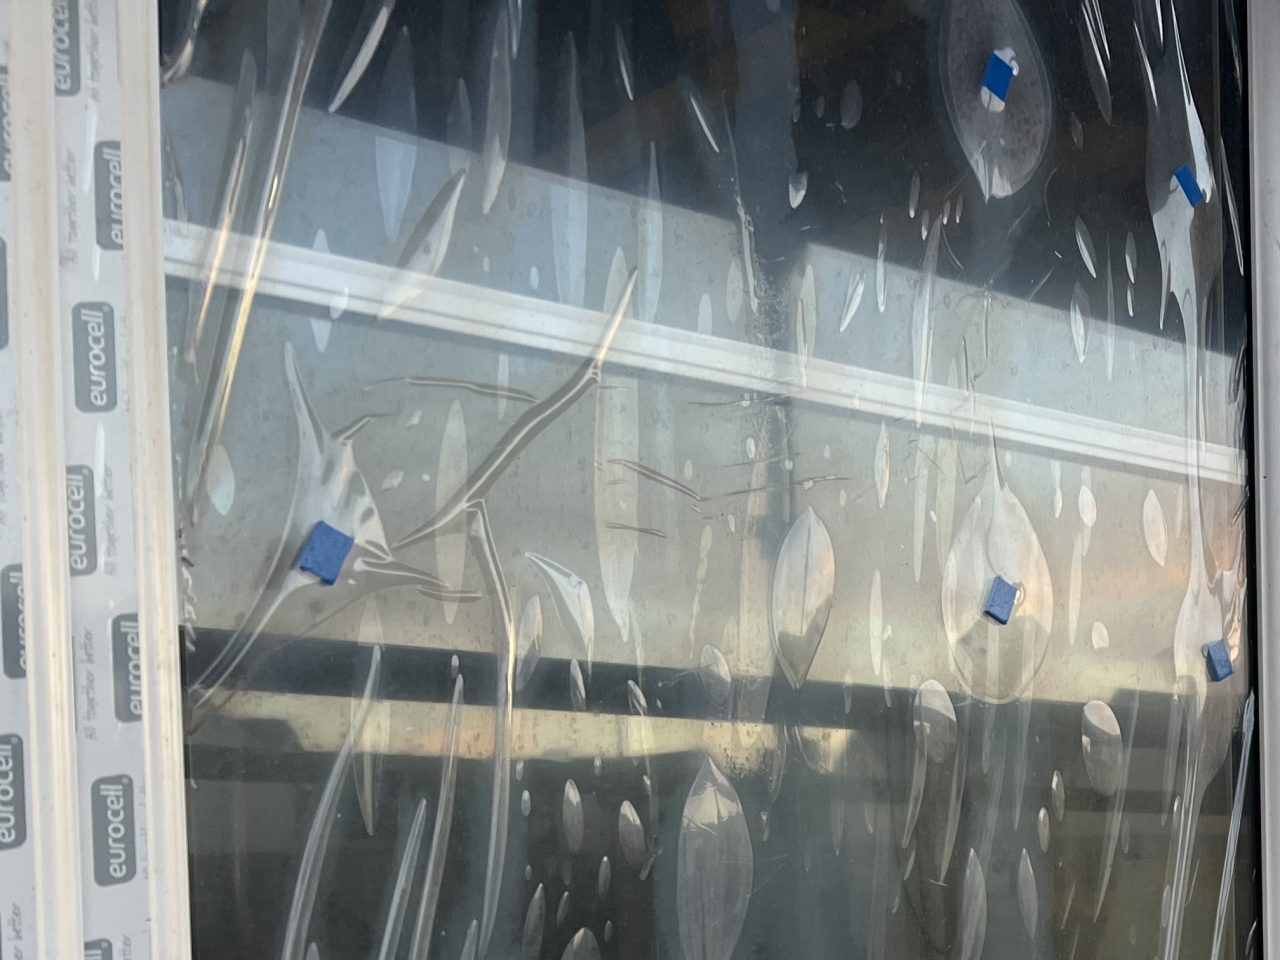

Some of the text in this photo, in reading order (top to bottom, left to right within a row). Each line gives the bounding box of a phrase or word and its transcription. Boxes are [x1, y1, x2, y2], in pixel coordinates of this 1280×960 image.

[54, 0, 72, 90] euroce
[80, 310, 106, 406] eurocell
[66, 473, 86, 570] eurocell
[100, 785, 127, 878] eurocell
